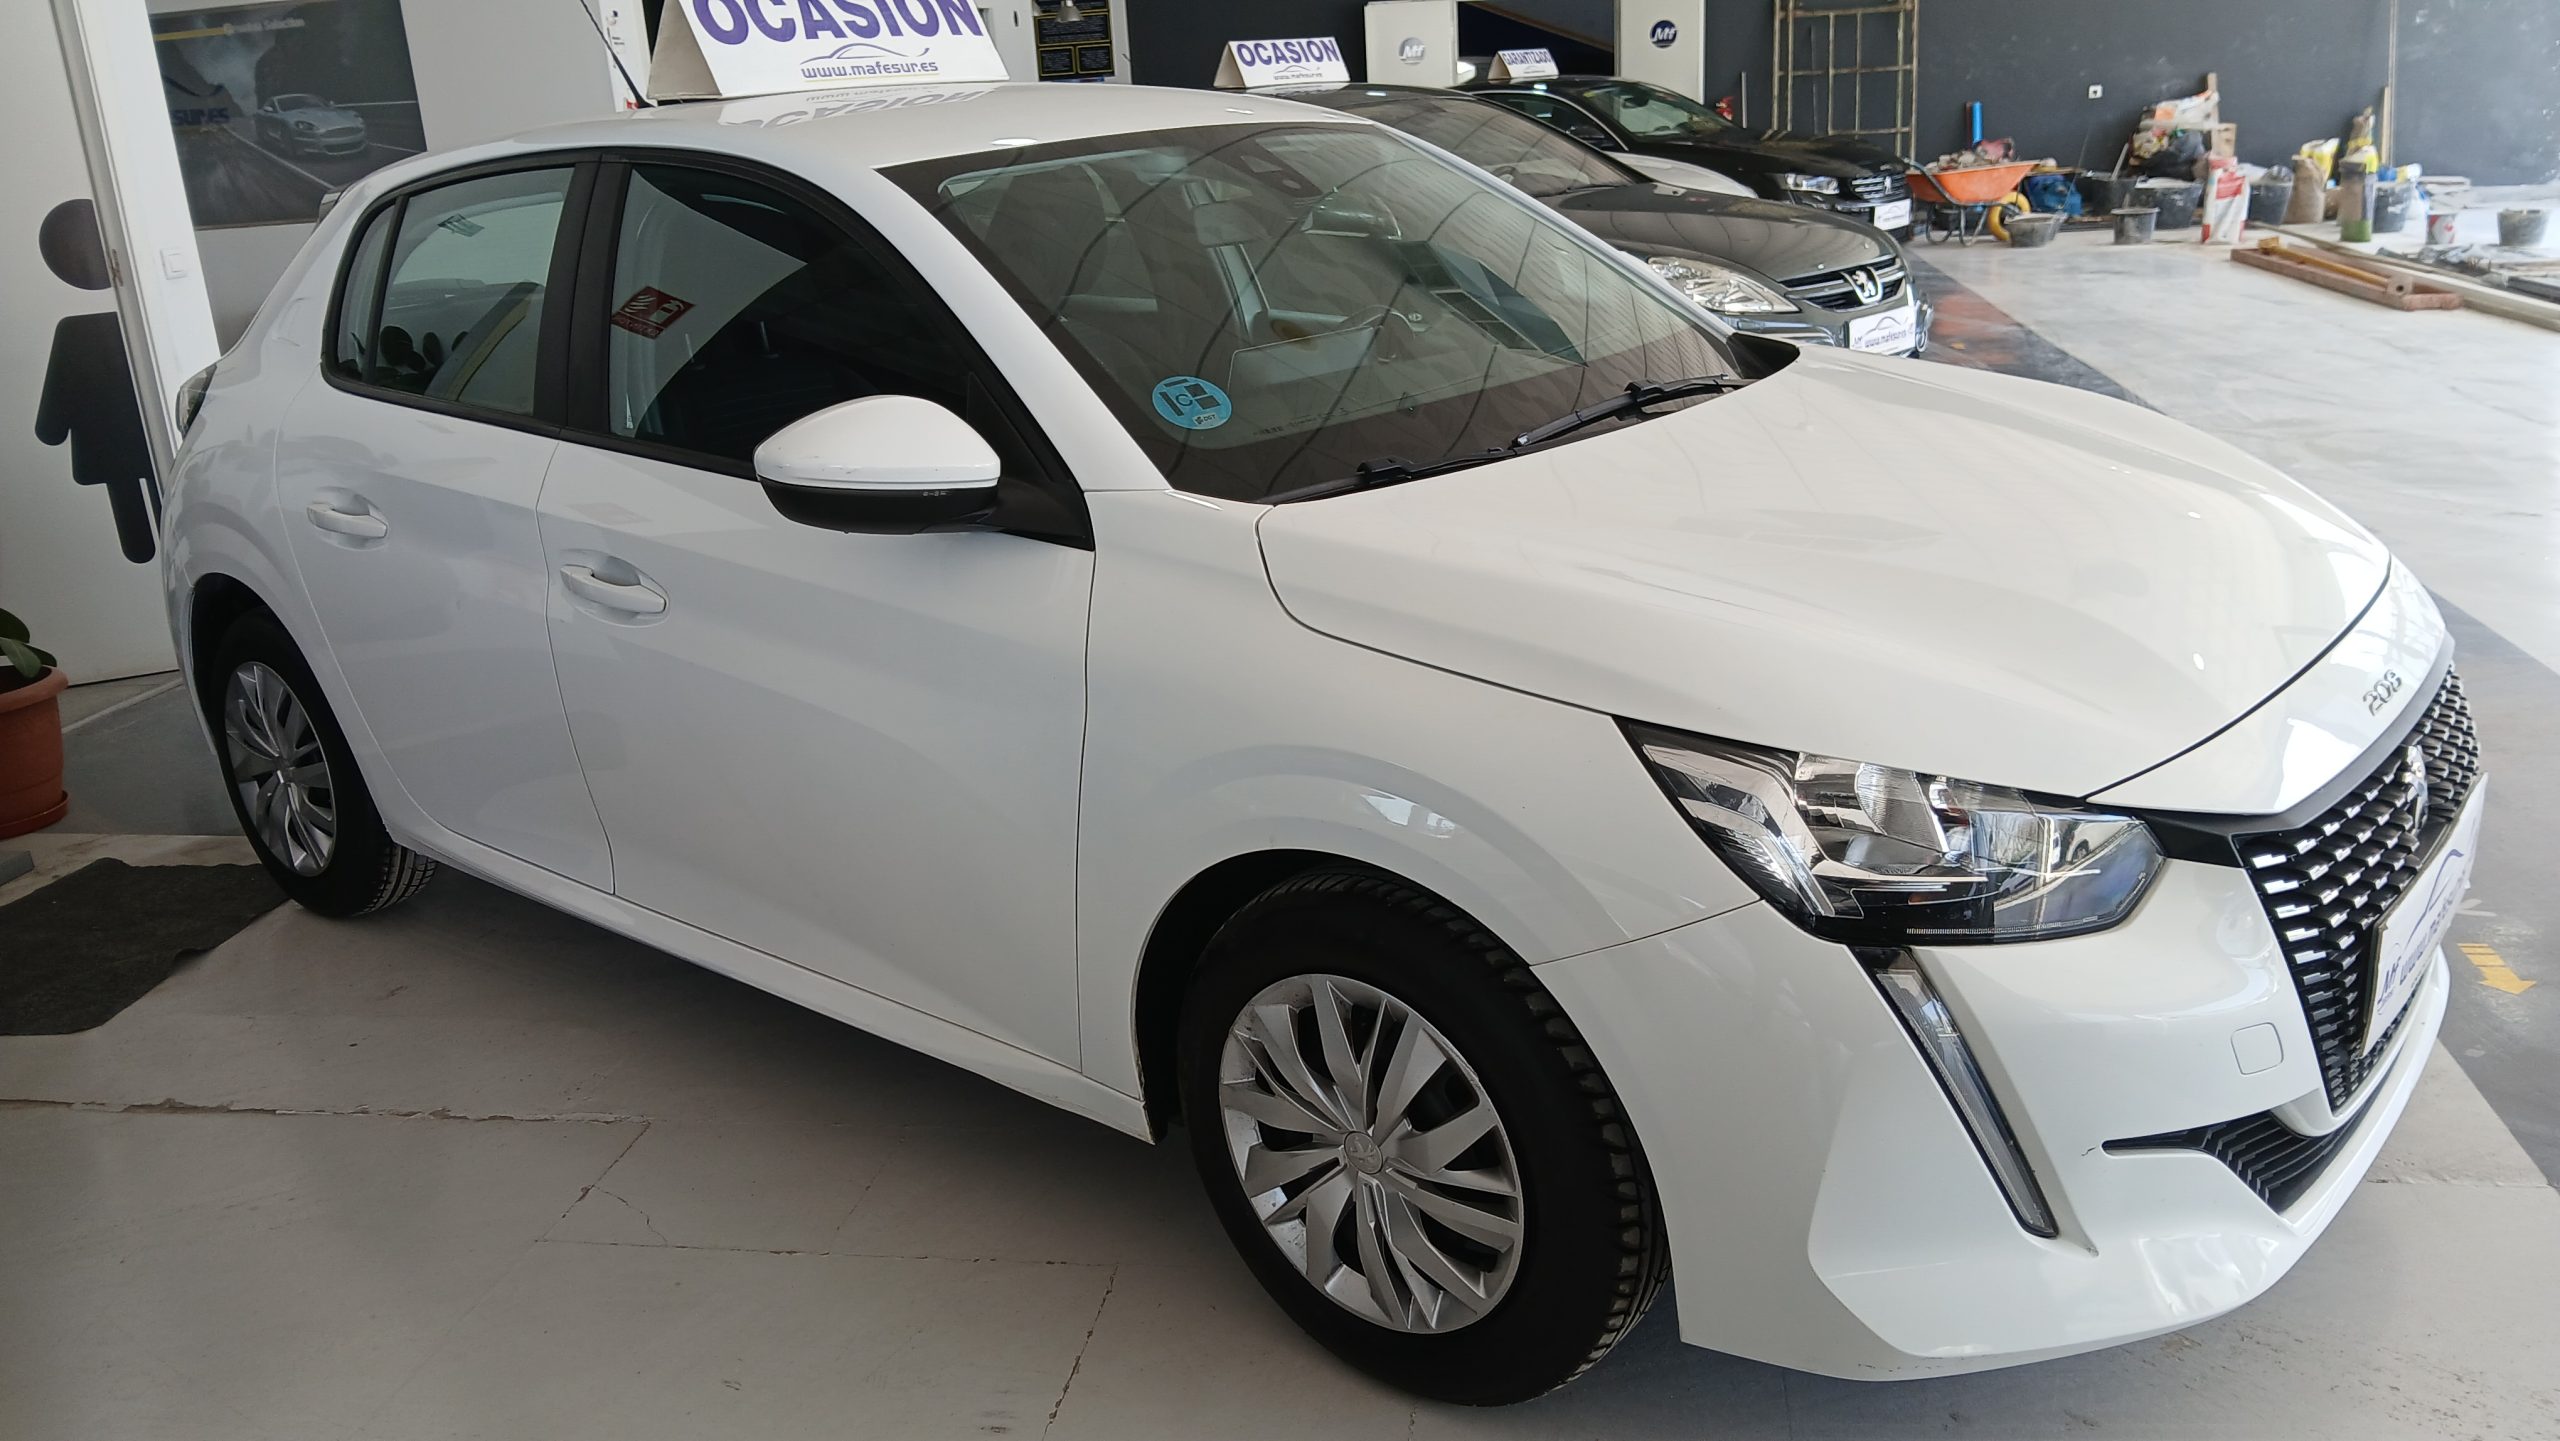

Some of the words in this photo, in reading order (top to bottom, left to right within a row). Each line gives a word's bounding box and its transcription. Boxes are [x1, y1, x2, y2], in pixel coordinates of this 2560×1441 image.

[692, 0, 984, 45] OCASION
[1236, 39, 1341, 67] OCASION
[800, 60, 940, 79] www.mafesur.es
[1203, 414, 1216, 422] DGT
[2362, 668, 2403, 717] 208
